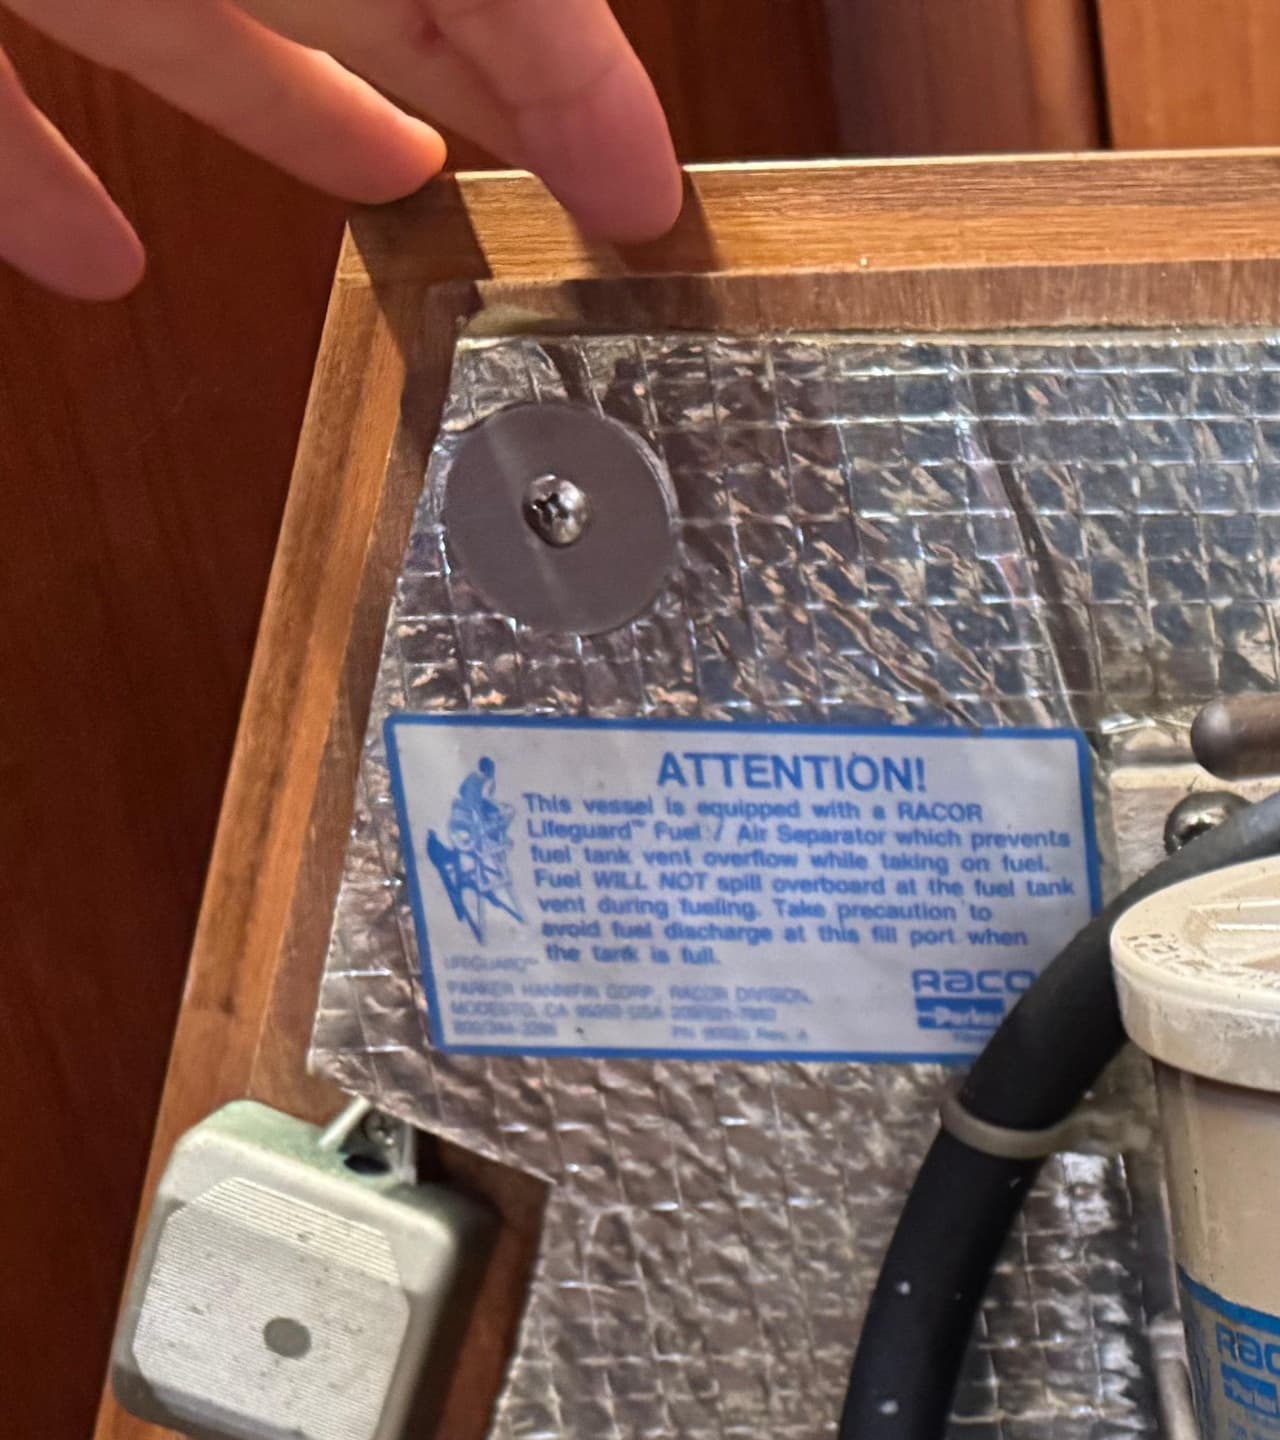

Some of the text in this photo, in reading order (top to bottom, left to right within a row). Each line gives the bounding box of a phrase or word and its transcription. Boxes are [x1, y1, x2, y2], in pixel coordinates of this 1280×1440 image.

[656, 751, 927, 793] ATTENTION!
[522, 792, 984, 825] This vessel is equipped with a RACOR
[653, 822, 701, 841] Fuel
[737, 824, 767, 843] Air
[777, 823, 886, 849] Separator
[895, 828, 961, 848] which
[970, 830, 1071, 851] prevents
[530, 843, 1050, 875] fuel tank vent overflow while taking on fuel.
[533, 868, 1076, 898] Fuel WILL NOT spill overboard at the fuel tank
[538, 896, 586, 914] vent
[597, 896, 669, 920] during
[773, 898, 827, 918] Take
[837, 901, 957, 926] precaution
[969, 903, 993, 922] to
[541, 919, 1029, 948] avoid fuel discharge at this fill port when
[545, 943, 581, 963] the
[592, 944, 639, 964] tank
[651, 946, 670, 964] is
